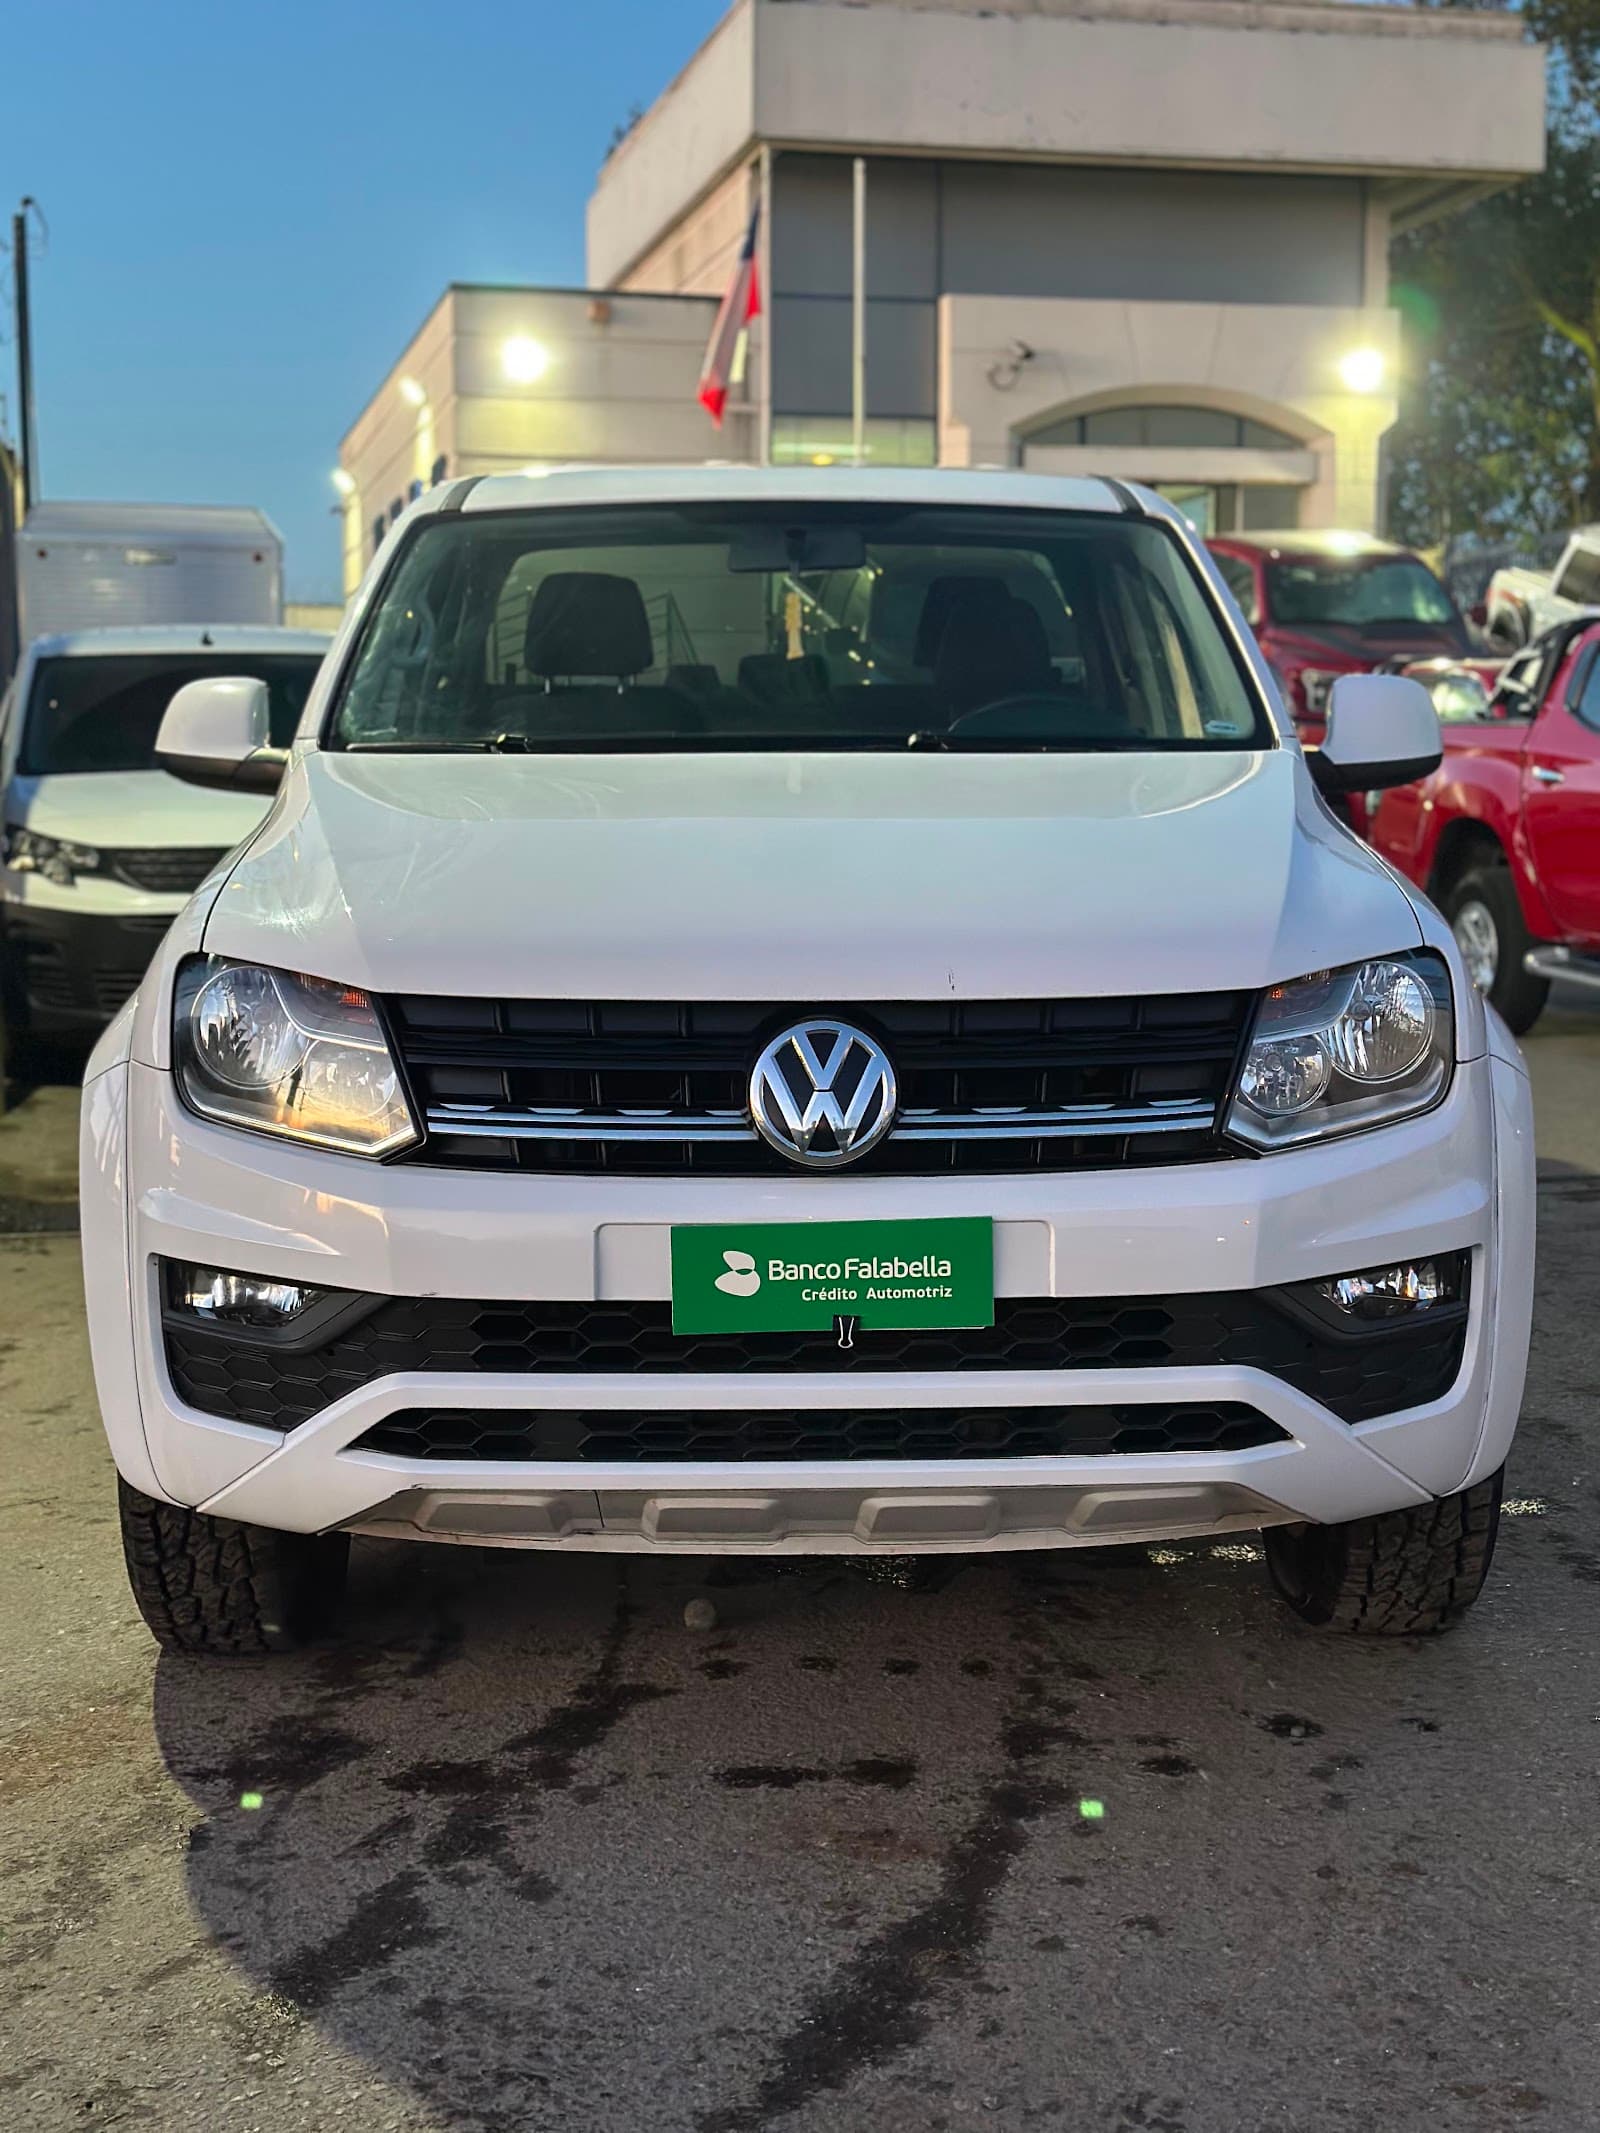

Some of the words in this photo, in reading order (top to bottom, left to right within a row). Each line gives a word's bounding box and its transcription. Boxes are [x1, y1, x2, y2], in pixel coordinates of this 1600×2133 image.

[751, 1021, 897, 1166] VW
[768, 1259, 841, 1281] Banco
[844, 1255, 952, 1279] Falabella
[801, 1287, 858, 1302] Crédito
[866, 1284, 953, 1300] Automotriz
